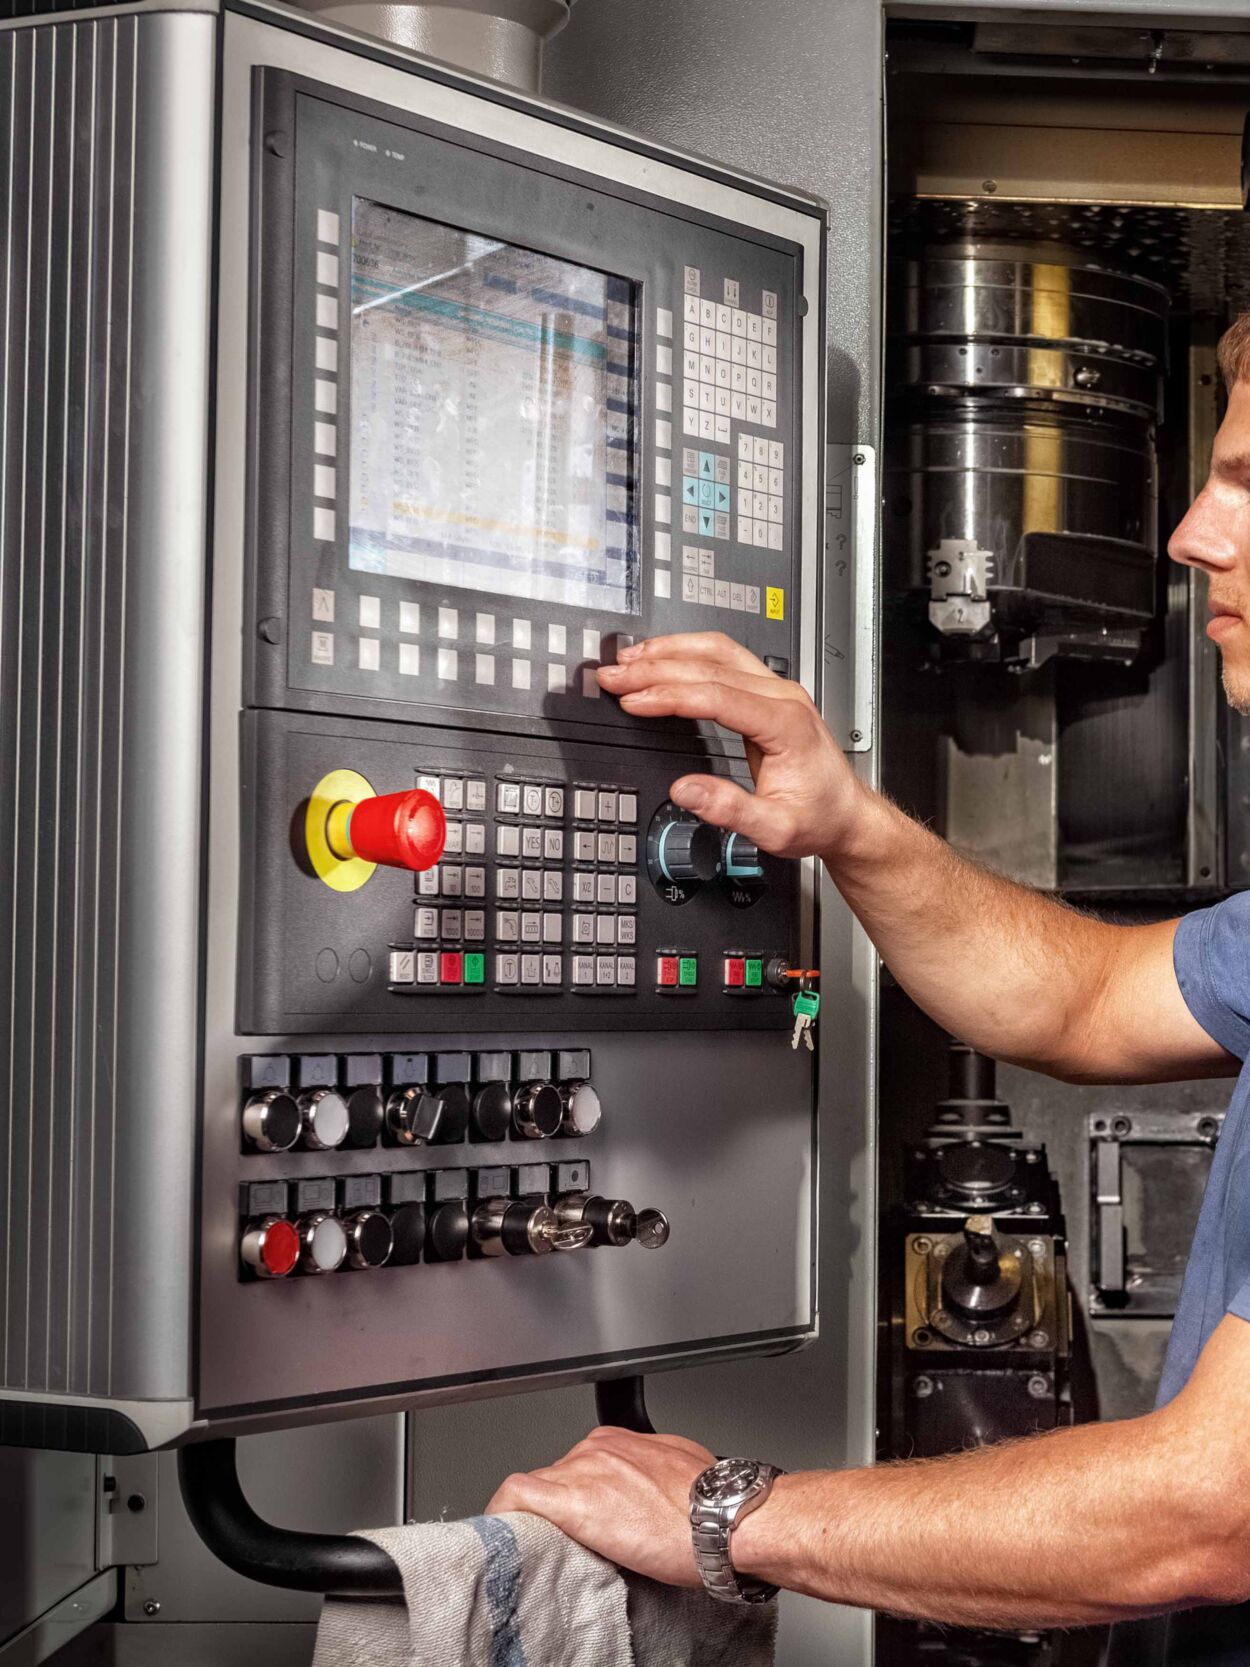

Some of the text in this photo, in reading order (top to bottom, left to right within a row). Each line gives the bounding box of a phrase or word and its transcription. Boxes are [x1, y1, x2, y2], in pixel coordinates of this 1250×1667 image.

[689, 304, 695, 314] A
[705, 308, 711, 319] B
[721, 313, 727, 324] C
[736, 317, 742, 328] D
[752, 322, 757, 333] E
[767, 326, 772, 336] F
[689, 332, 695, 343] G
[705, 336, 711, 347] H
[737, 346, 742, 356] J
[752, 350, 757, 360] K
[767, 354, 772, 364] L
[688, 360, 695, 370] M
[704, 365, 711, 375] N
[720, 368, 727, 379] O
[736, 373, 742, 382] P
[751, 377, 757, 388] Q
[766, 381, 772, 392] R
[688, 388, 694, 399] S
[705, 392, 710, 402] T
[720, 396, 726, 407] U
[736, 400, 742, 410] V
[750, 404, 758, 414] W
[766, 408, 772, 418] X
[688, 416, 694, 426] Y
[704, 420, 710, 431] Z
[743, 442, 748, 452] 7
[758, 446, 764, 456] 8
[743, 471, 748, 480] 4
[758, 473, 764, 484] 5
[758, 502, 764, 511] 2
[773, 504, 778, 514] 3
[685, 513, 696, 524] END
[758, 528, 763, 538] 0
[700, 586, 713, 596] CTRL
[717, 590, 727, 599] ALT
[732, 593, 742, 602] DEL
[525, 836, 540, 849] YES
[549, 837, 560, 851] NO
[582, 881, 592, 893] X/Z
[624, 883, 632, 896] C
[599, 961, 614, 969] KANAL
